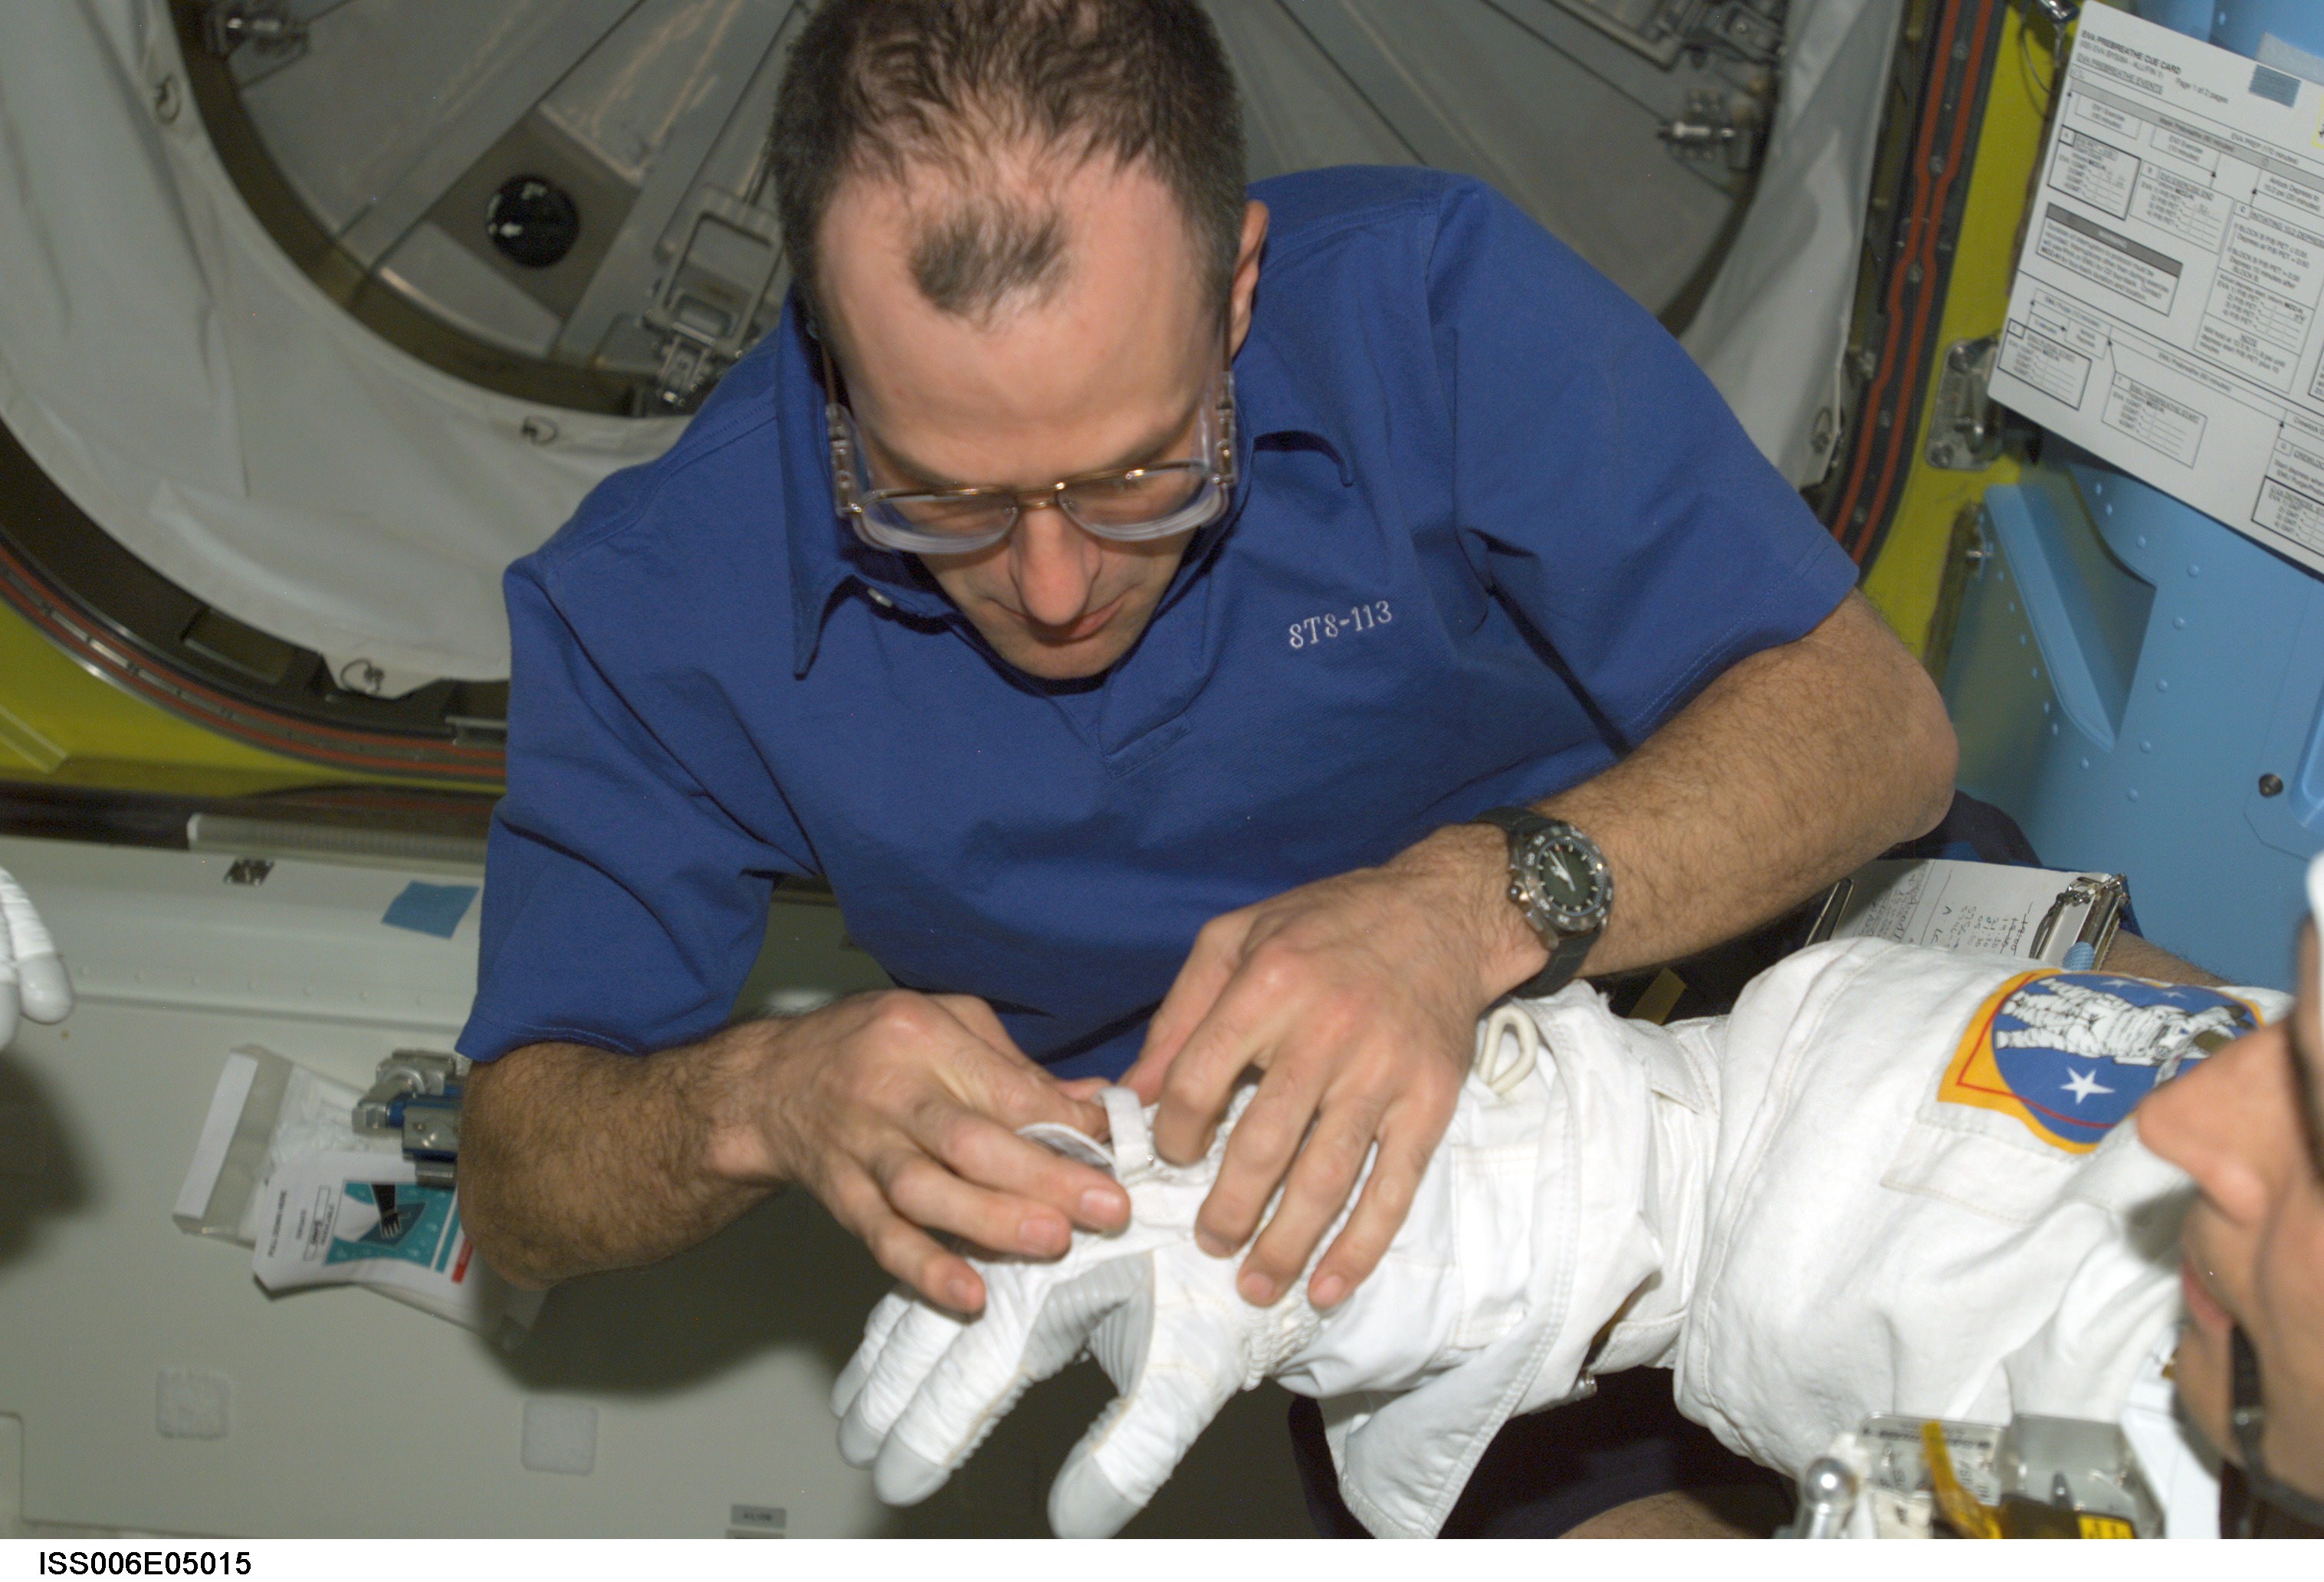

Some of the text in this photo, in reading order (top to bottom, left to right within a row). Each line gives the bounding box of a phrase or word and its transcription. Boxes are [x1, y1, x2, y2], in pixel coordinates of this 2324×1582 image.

[2082, 31, 2095, 41] EVA
[2098, 37, 2142, 59] PREBREATHE
[2145, 55, 2158, 66] CUE
[2162, 61, 2181, 74] CARD
[2135, 77, 2162, 94] EVENTS
[1288, 600, 1392, 648] STS-113
